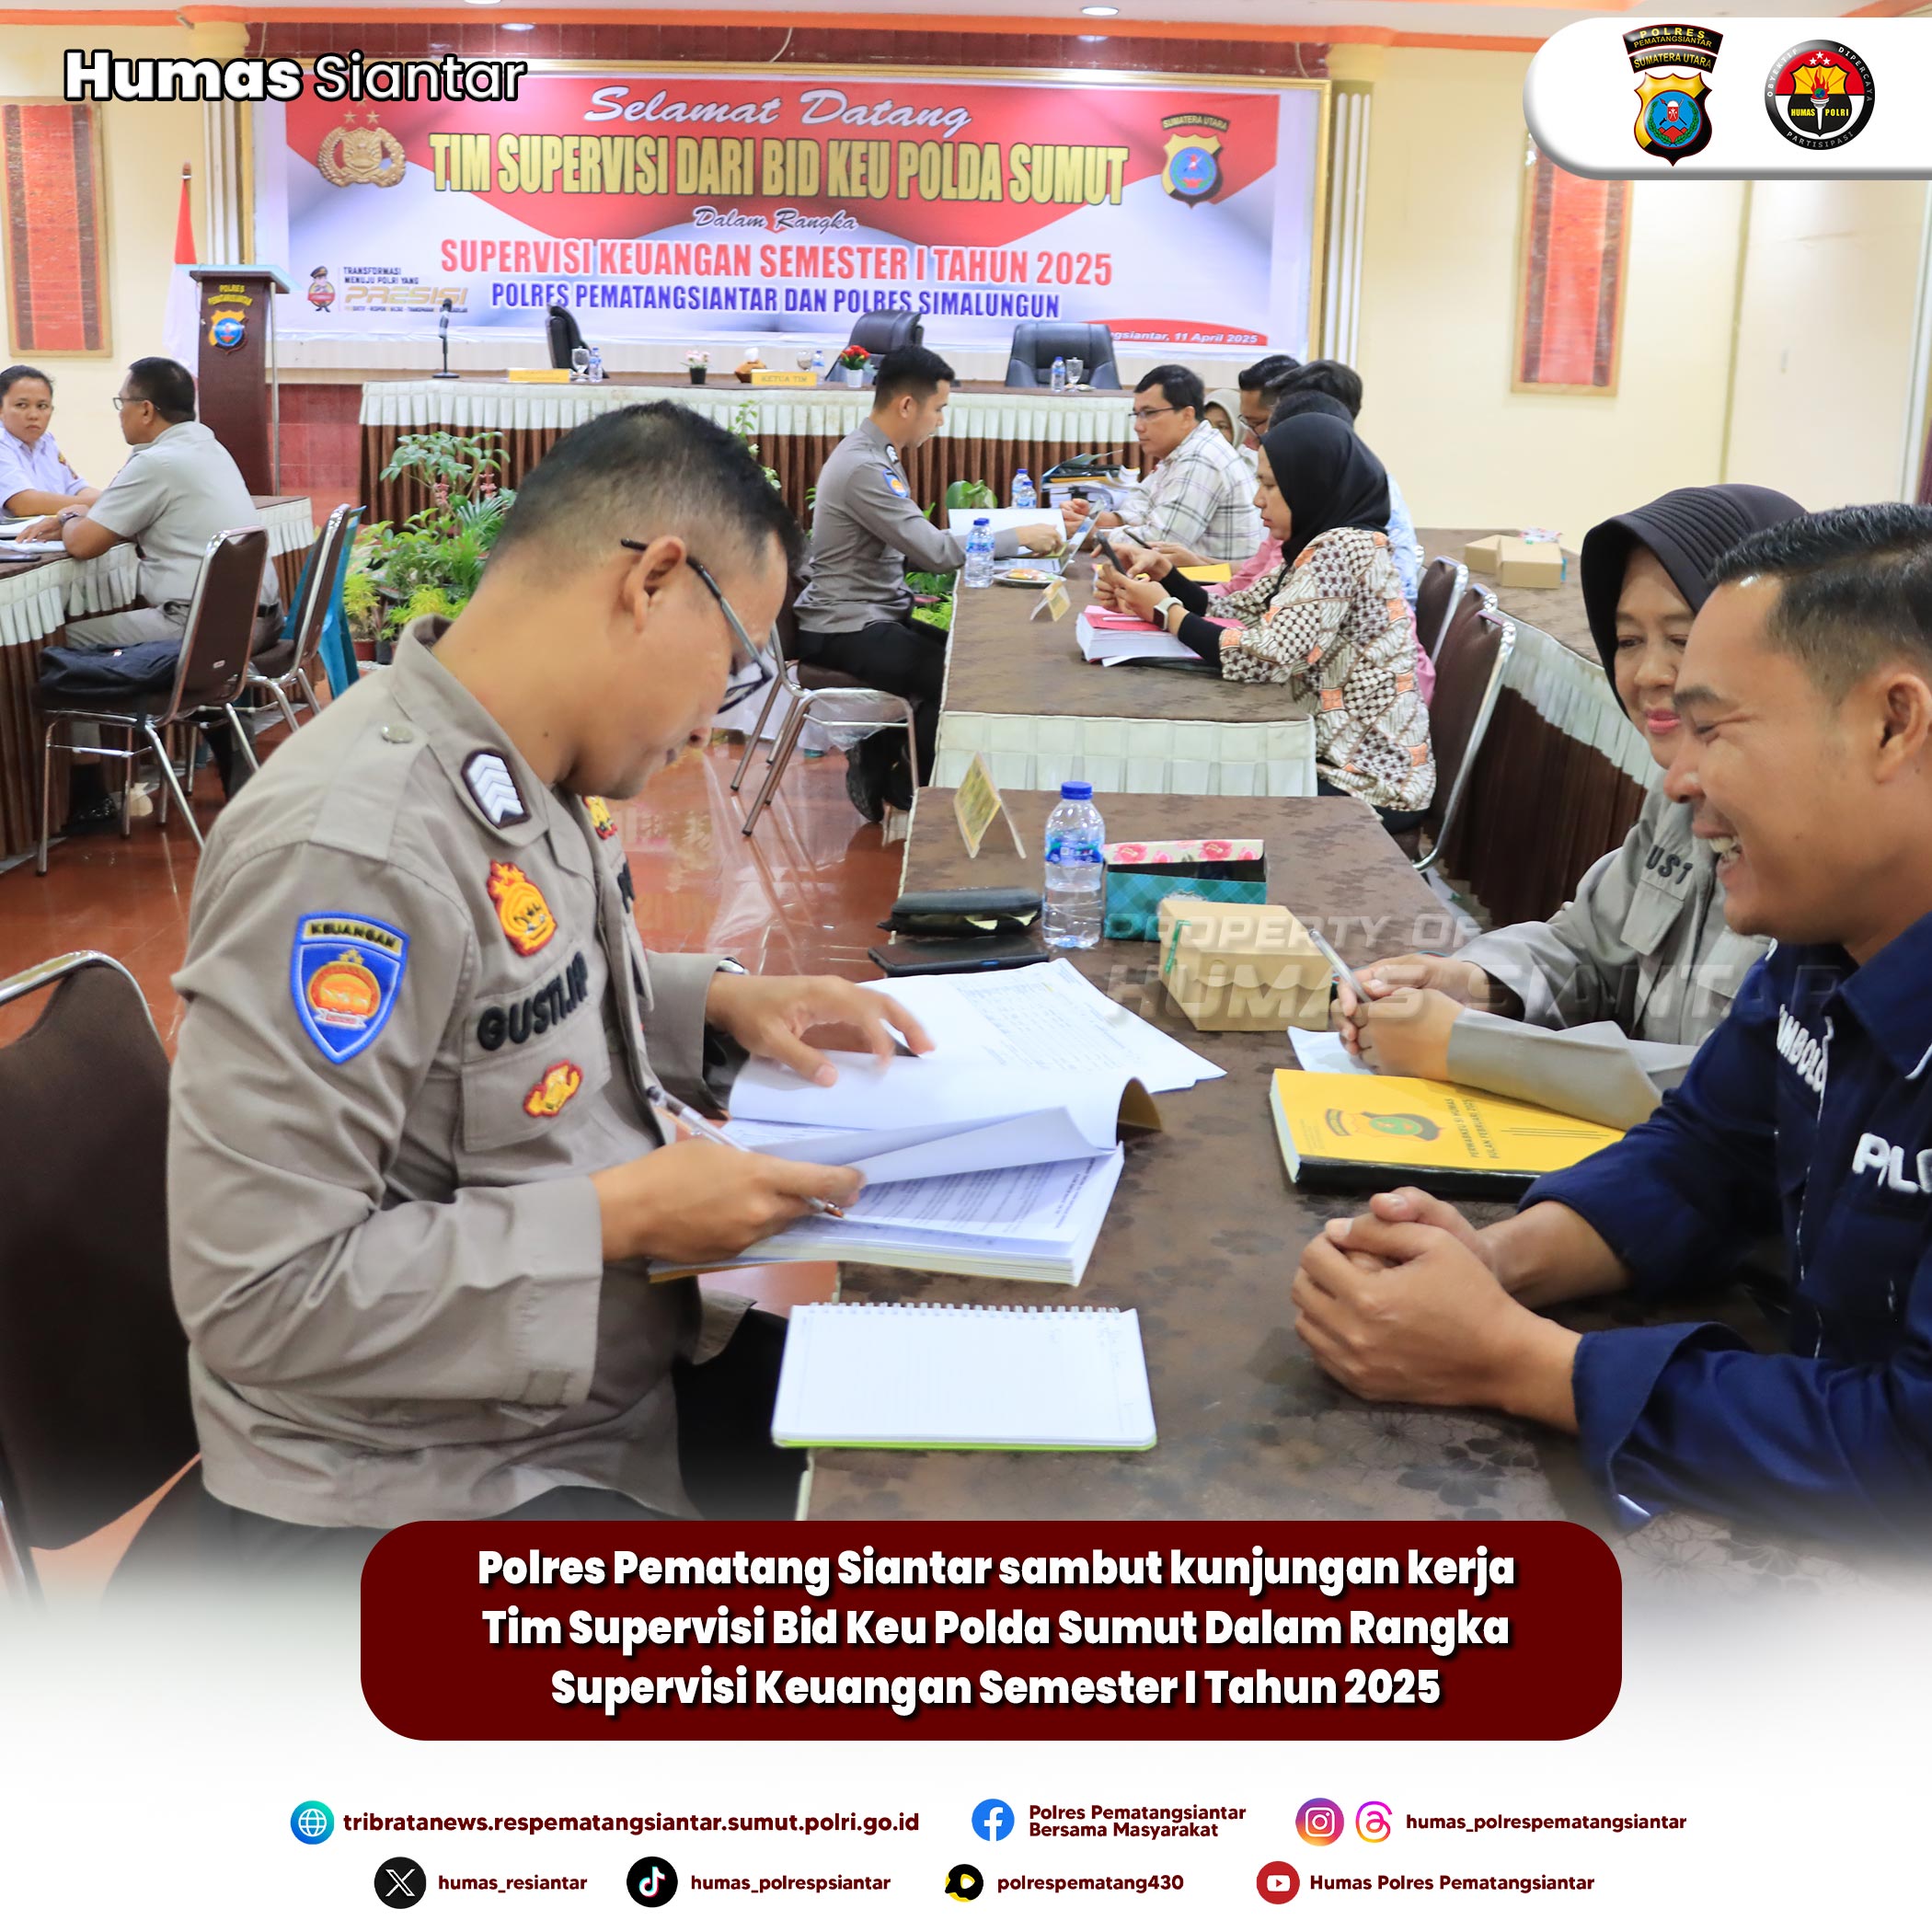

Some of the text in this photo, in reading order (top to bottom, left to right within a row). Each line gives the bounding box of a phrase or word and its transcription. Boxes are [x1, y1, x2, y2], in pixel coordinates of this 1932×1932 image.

[583, 86, 972, 139] Selamat Datang
[1162, 114, 1228, 131] SUMATERA UTARA
[428, 132, 1130, 205] TIM SUPERVISI DARI BID KEU POLDA SUMUT
[694, 206, 858, 236] Dalam Rangka
[343, 267, 402, 275] TRANSFORMASI
[440, 238, 1112, 286] SUPERVISI KEUANGAN SEMESTER I TAHUN 2025
[344, 276, 375, 284] MENUJU
[401, 277, 420, 285] YANG
[345, 286, 469, 305] PRESISI
[492, 282, 1060, 318] POLRES PEMATANGSIANTAR DAN POLRES SIMALUNGUN
[1174, 332, 1188, 342] 11
[1190, 332, 1224, 344] April
[1226, 334, 1259, 344] 2025
